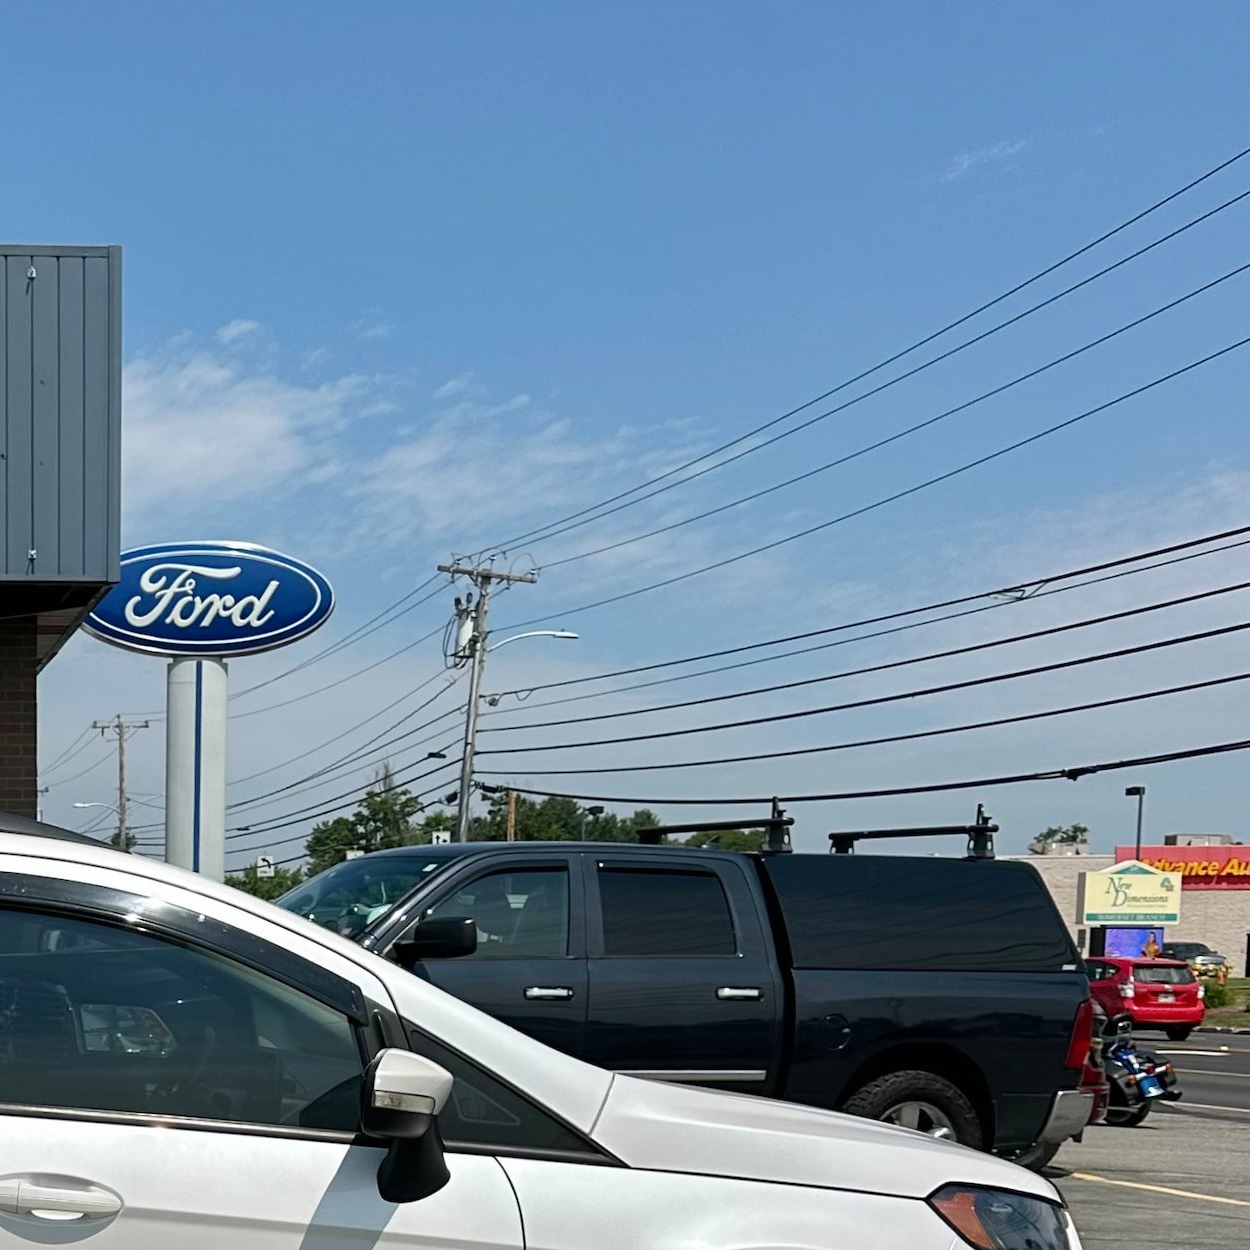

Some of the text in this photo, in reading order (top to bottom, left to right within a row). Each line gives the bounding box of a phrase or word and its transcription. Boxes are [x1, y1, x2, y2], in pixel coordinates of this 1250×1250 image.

[124, 562, 281, 628] Ford
[1104, 876, 1133, 894] New
[1111, 889, 1169, 907] Dimensions
